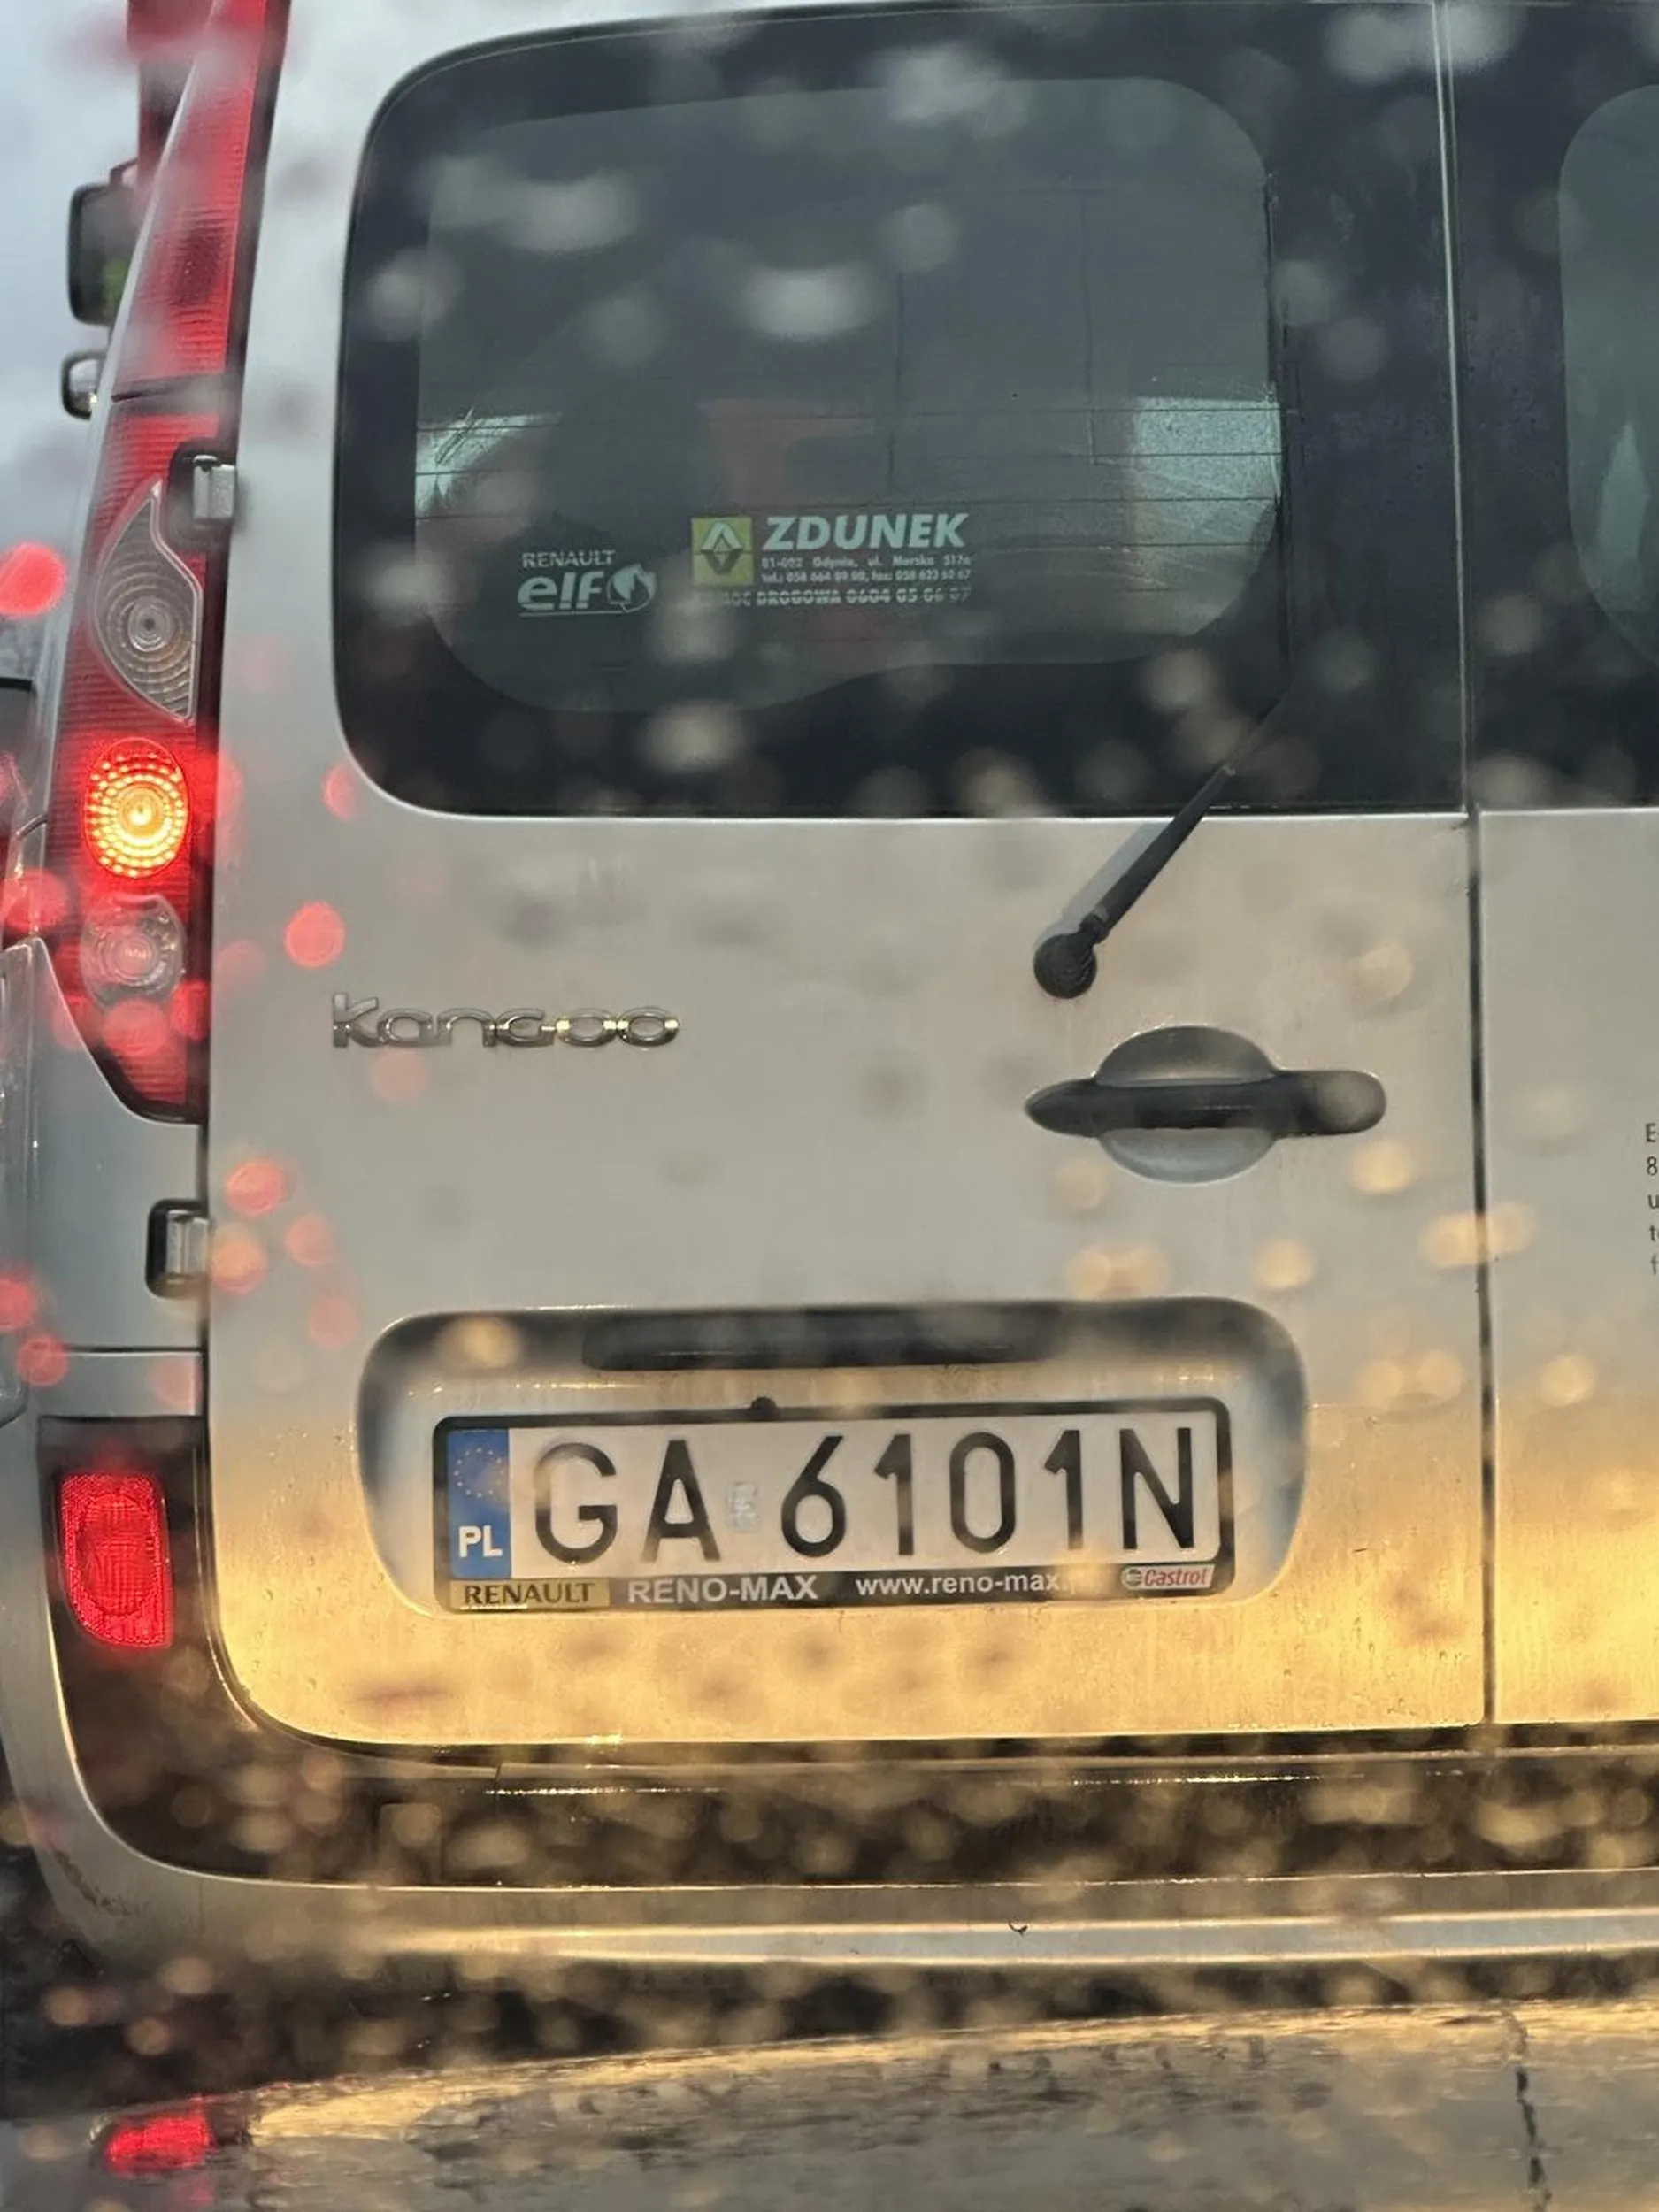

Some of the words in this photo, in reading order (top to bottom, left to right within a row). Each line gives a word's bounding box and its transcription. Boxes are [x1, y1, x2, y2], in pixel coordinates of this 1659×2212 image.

[762, 512, 970, 550] ZDUNEK
[522, 549, 616, 569] RENAULT
[517, 571, 605, 611] elf
[333, 992, 680, 1048] Kangoo
[533, 1439, 721, 1564] GA
[780, 1427, 1196, 1558] 6101N
[457, 1525, 503, 1559] PL
[464, 1580, 595, 1606] RENAULT
[626, 1575, 819, 1604] RENO-MAX
[1144, 1567, 1210, 1587] Castrol
